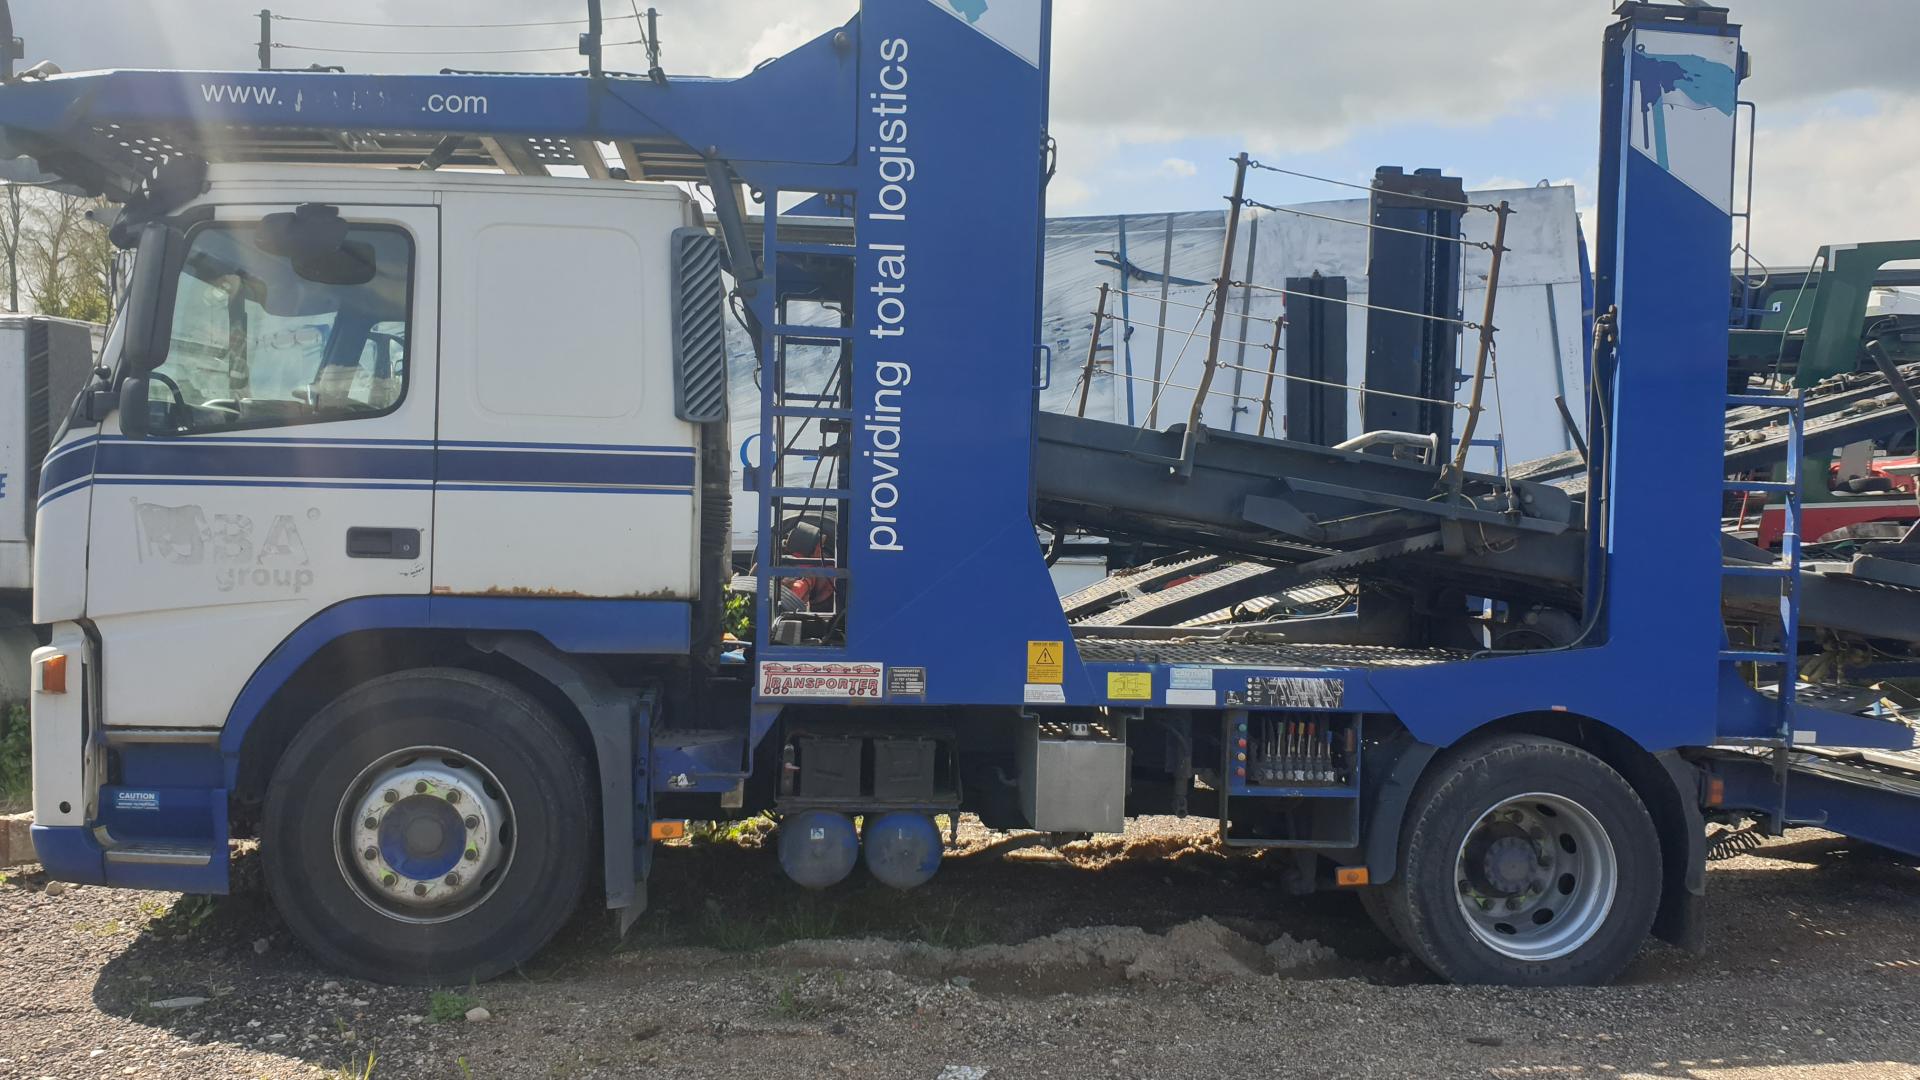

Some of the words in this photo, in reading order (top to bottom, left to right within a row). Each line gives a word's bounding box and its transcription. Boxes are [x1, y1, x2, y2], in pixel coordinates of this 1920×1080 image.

[201, 84, 283, 104] www.
[421, 93, 488, 114] .com
[869, 38, 916, 220] logistics
[869, 243, 906, 339] total
[863, 361, 912, 551] providing
[216, 567, 314, 593] group
[765, 671, 880, 692] TRANSPORTER
[119, 792, 155, 800] CAUTION
